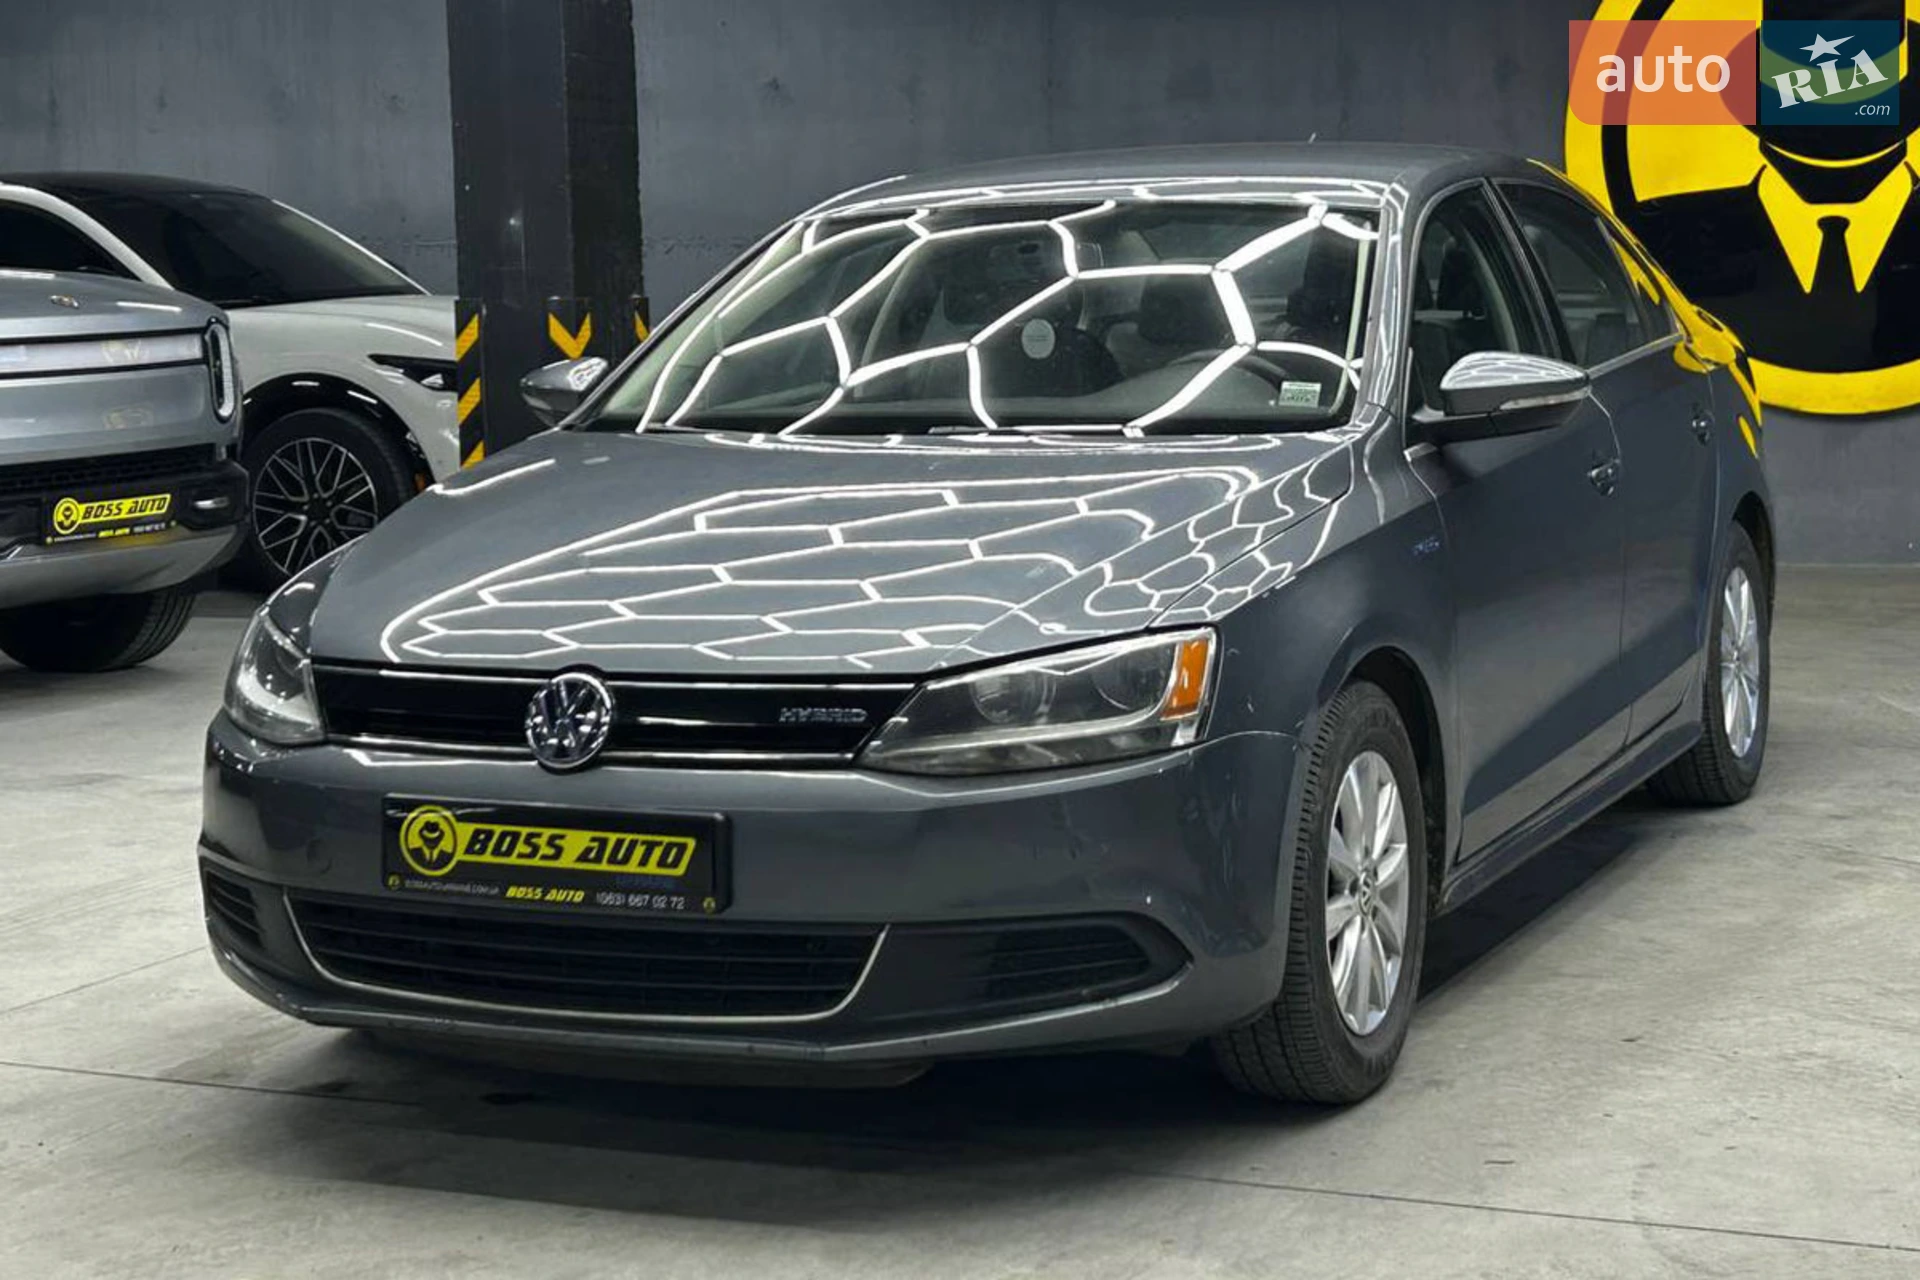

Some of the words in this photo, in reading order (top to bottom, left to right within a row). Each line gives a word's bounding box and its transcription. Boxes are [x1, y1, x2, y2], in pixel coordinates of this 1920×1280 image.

[82, 502, 123, 519] BOSS
[127, 498, 167, 514] AUTO
[779, 707, 868, 722] HYBRID
[463, 828, 568, 862] BOSS
[574, 836, 689, 869] AUTO
[505, 886, 542, 899] BOSS
[544, 889, 585, 903] AUTO
[670, 896, 685, 910] 72
